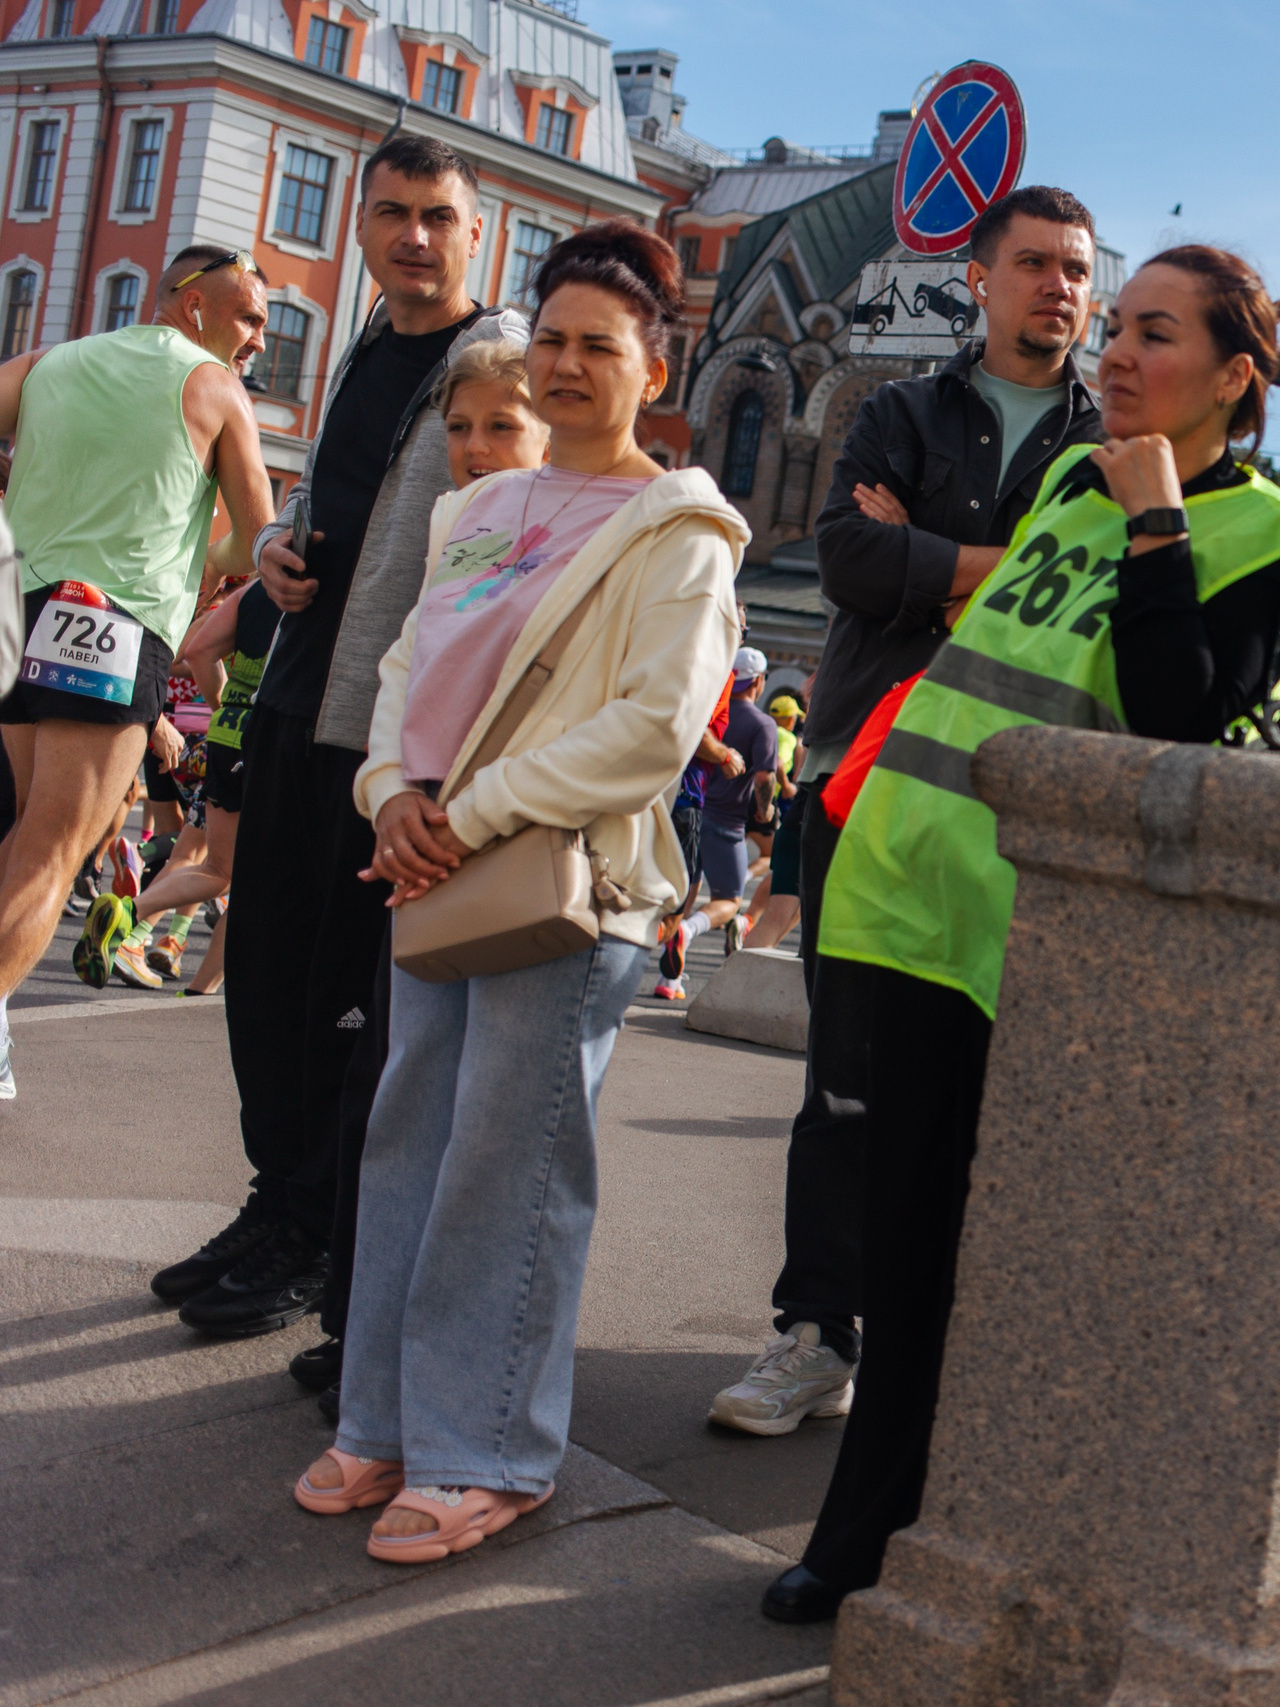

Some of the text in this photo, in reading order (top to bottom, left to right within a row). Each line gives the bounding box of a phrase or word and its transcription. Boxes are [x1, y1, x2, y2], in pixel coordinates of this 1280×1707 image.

[52, 610, 116, 653] 726
[59, 648, 100, 665] ПАВЕЛ
[28, 661, 40, 680] D
[336, 1020, 365, 1029] adida
